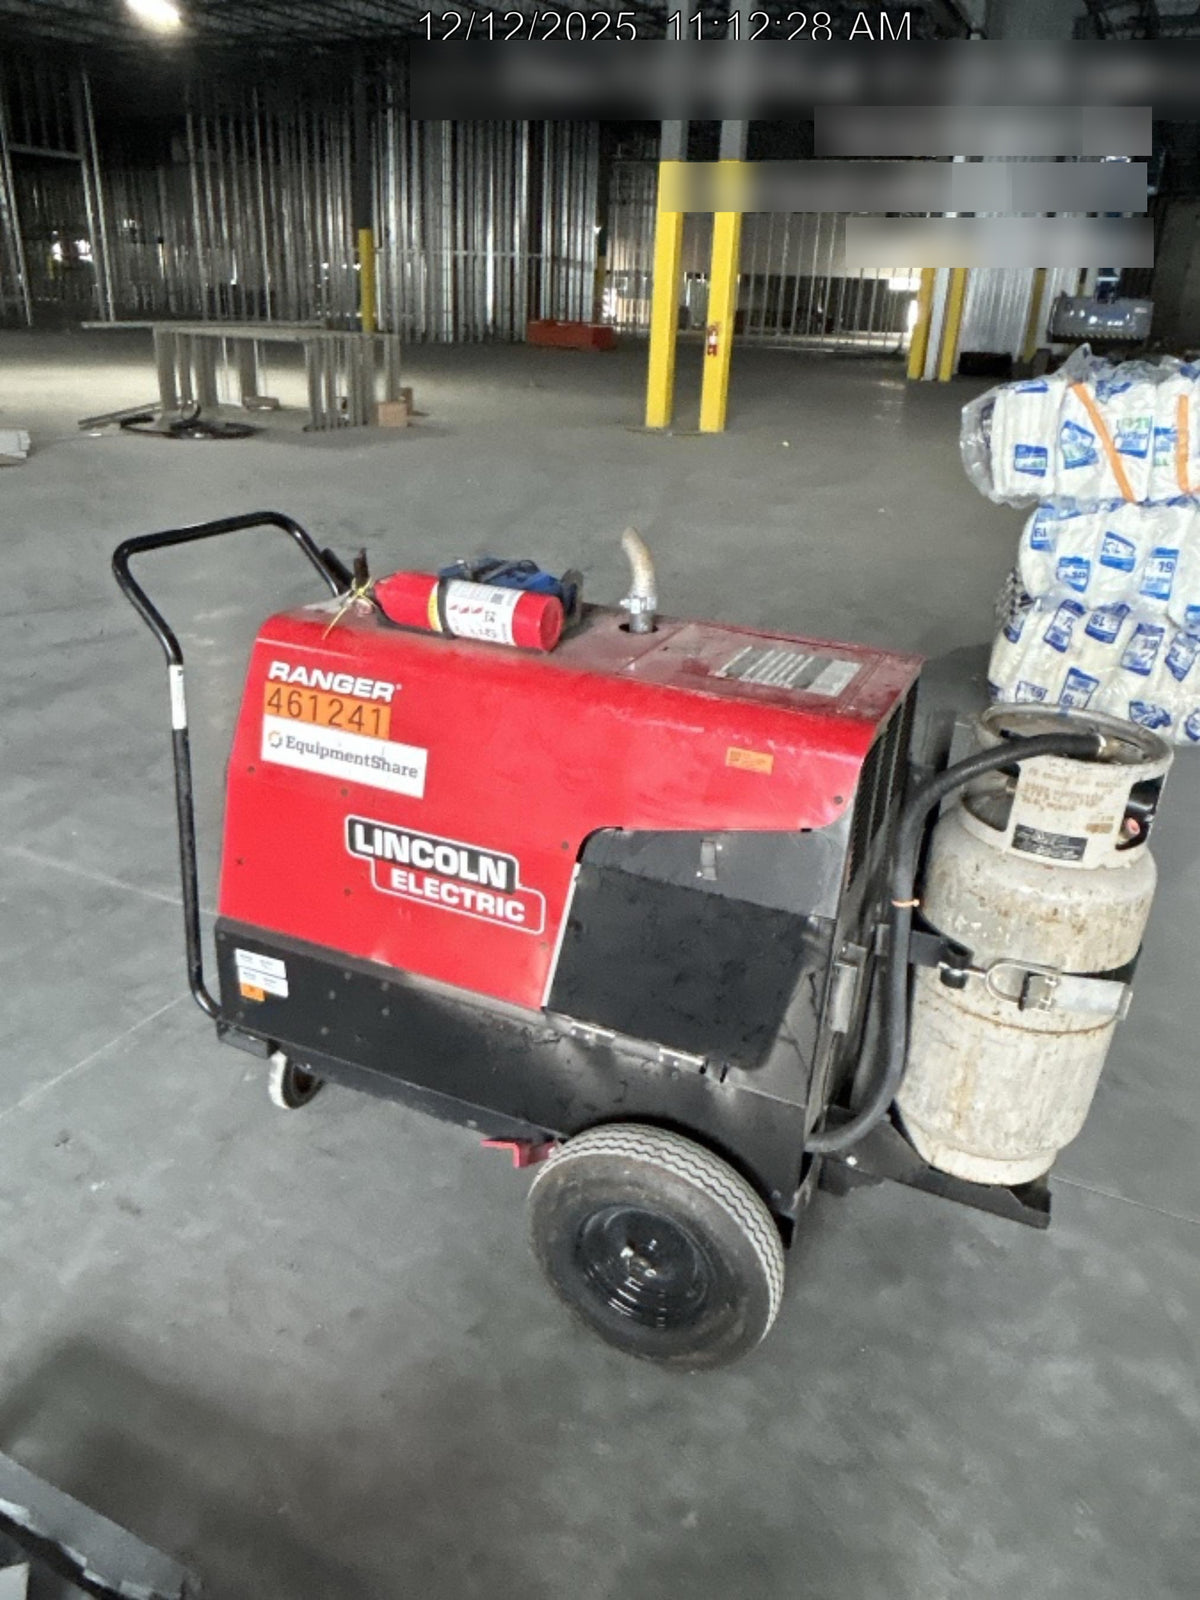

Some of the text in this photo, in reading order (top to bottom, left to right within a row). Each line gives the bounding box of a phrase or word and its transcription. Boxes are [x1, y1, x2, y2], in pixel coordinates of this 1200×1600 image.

[268, 661, 395, 702] RANGER
[267, 687, 383, 736] 461241
[285, 735, 419, 779] EquipmentShare
[354, 823, 508, 889] LINCOLN
[390, 867, 526, 923] ELECTRIC
